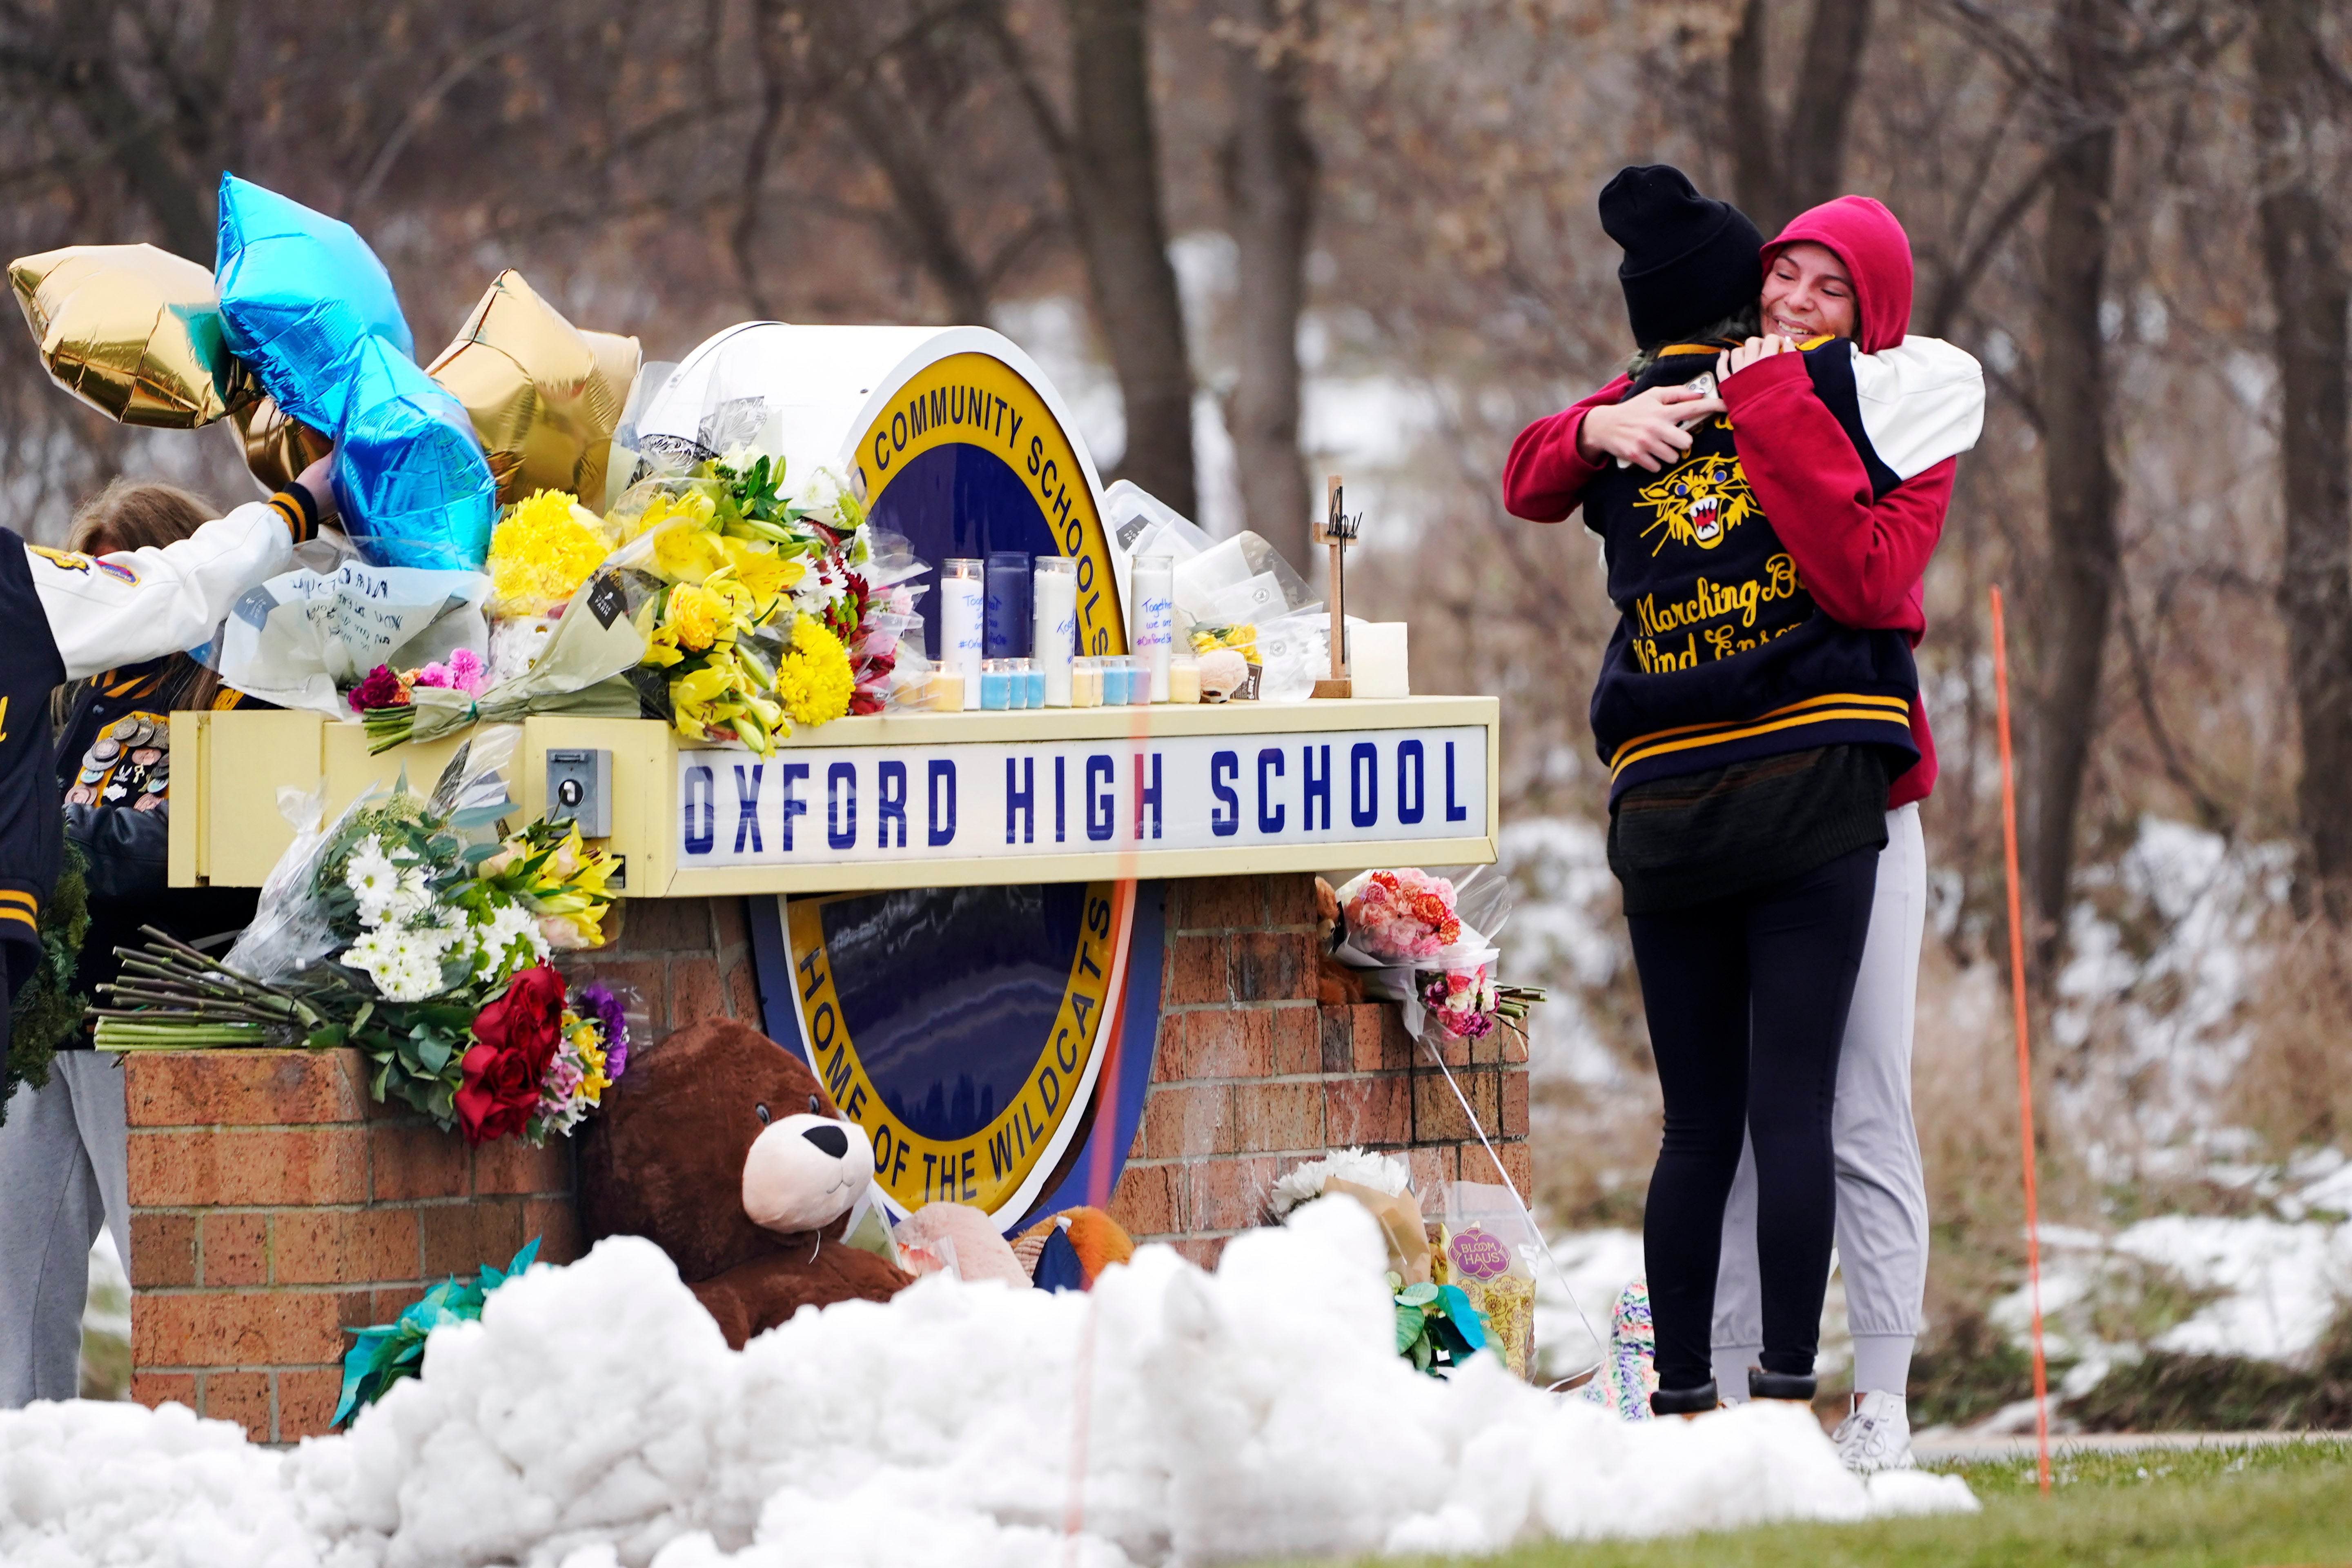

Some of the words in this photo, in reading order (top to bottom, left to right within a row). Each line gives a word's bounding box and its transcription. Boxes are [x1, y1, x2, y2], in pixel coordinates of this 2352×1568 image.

[875, 385, 1023, 471] COMMUNITY
[1027, 435, 1109, 656] SCHOOLS
[1146, 621, 1159, 629] we
[1636, 576, 1760, 637] Marching
[1633, 632, 1697, 674] Wind
[684, 759, 957, 855] OXFORD
[1005, 753, 1163, 845] HIGH
[1211, 739, 1467, 836] SCHOOL
[799, 947, 867, 1119] HOME
[873, 1124, 911, 1188] OF
[923, 1150, 977, 1203] THE
[989, 896, 1111, 1183] WILDCATS
[1461, 1242, 1497, 1253] BLOOM
[1465, 1252, 1500, 1265] HAUS
